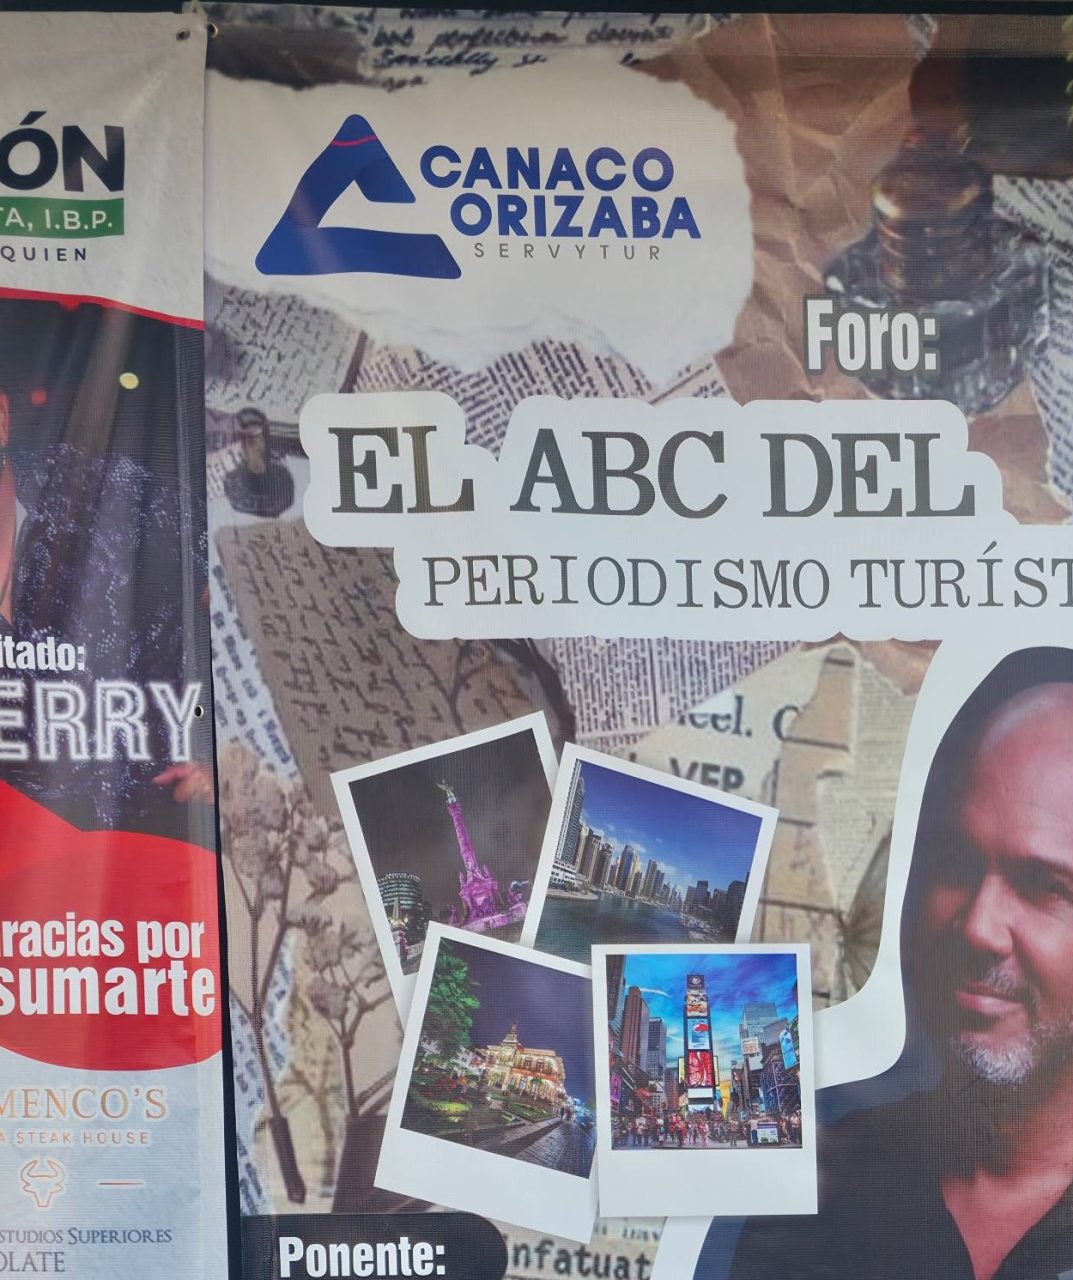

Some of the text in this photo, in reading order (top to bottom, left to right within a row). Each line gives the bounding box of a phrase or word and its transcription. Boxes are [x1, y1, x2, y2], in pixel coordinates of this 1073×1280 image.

[0, 111, 125, 192] ÓN
[419, 145, 674, 192] CANACO
[0, 207, 113, 231] A, I.B.P.
[450, 193, 701, 239] ORIZABA
[0, 245, 86, 262] QUIEN
[474, 242, 660, 261] SERVYTUR
[807, 299, 937, 371] Foro:
[328, 426, 475, 514] EL
[509, 427, 728, 519] ABC
[761, 432, 976, 518] DEL
[423, 555, 830, 610] PERIODISMO
[0, 912, 205, 963] racias por
[16, 1131, 71, 1144] STEAK
[83, 1131, 149, 1145] HOUSE
[68, 1227, 173, 1245] SUPERIORES
[279, 1236, 446, 1278] Ponente:
